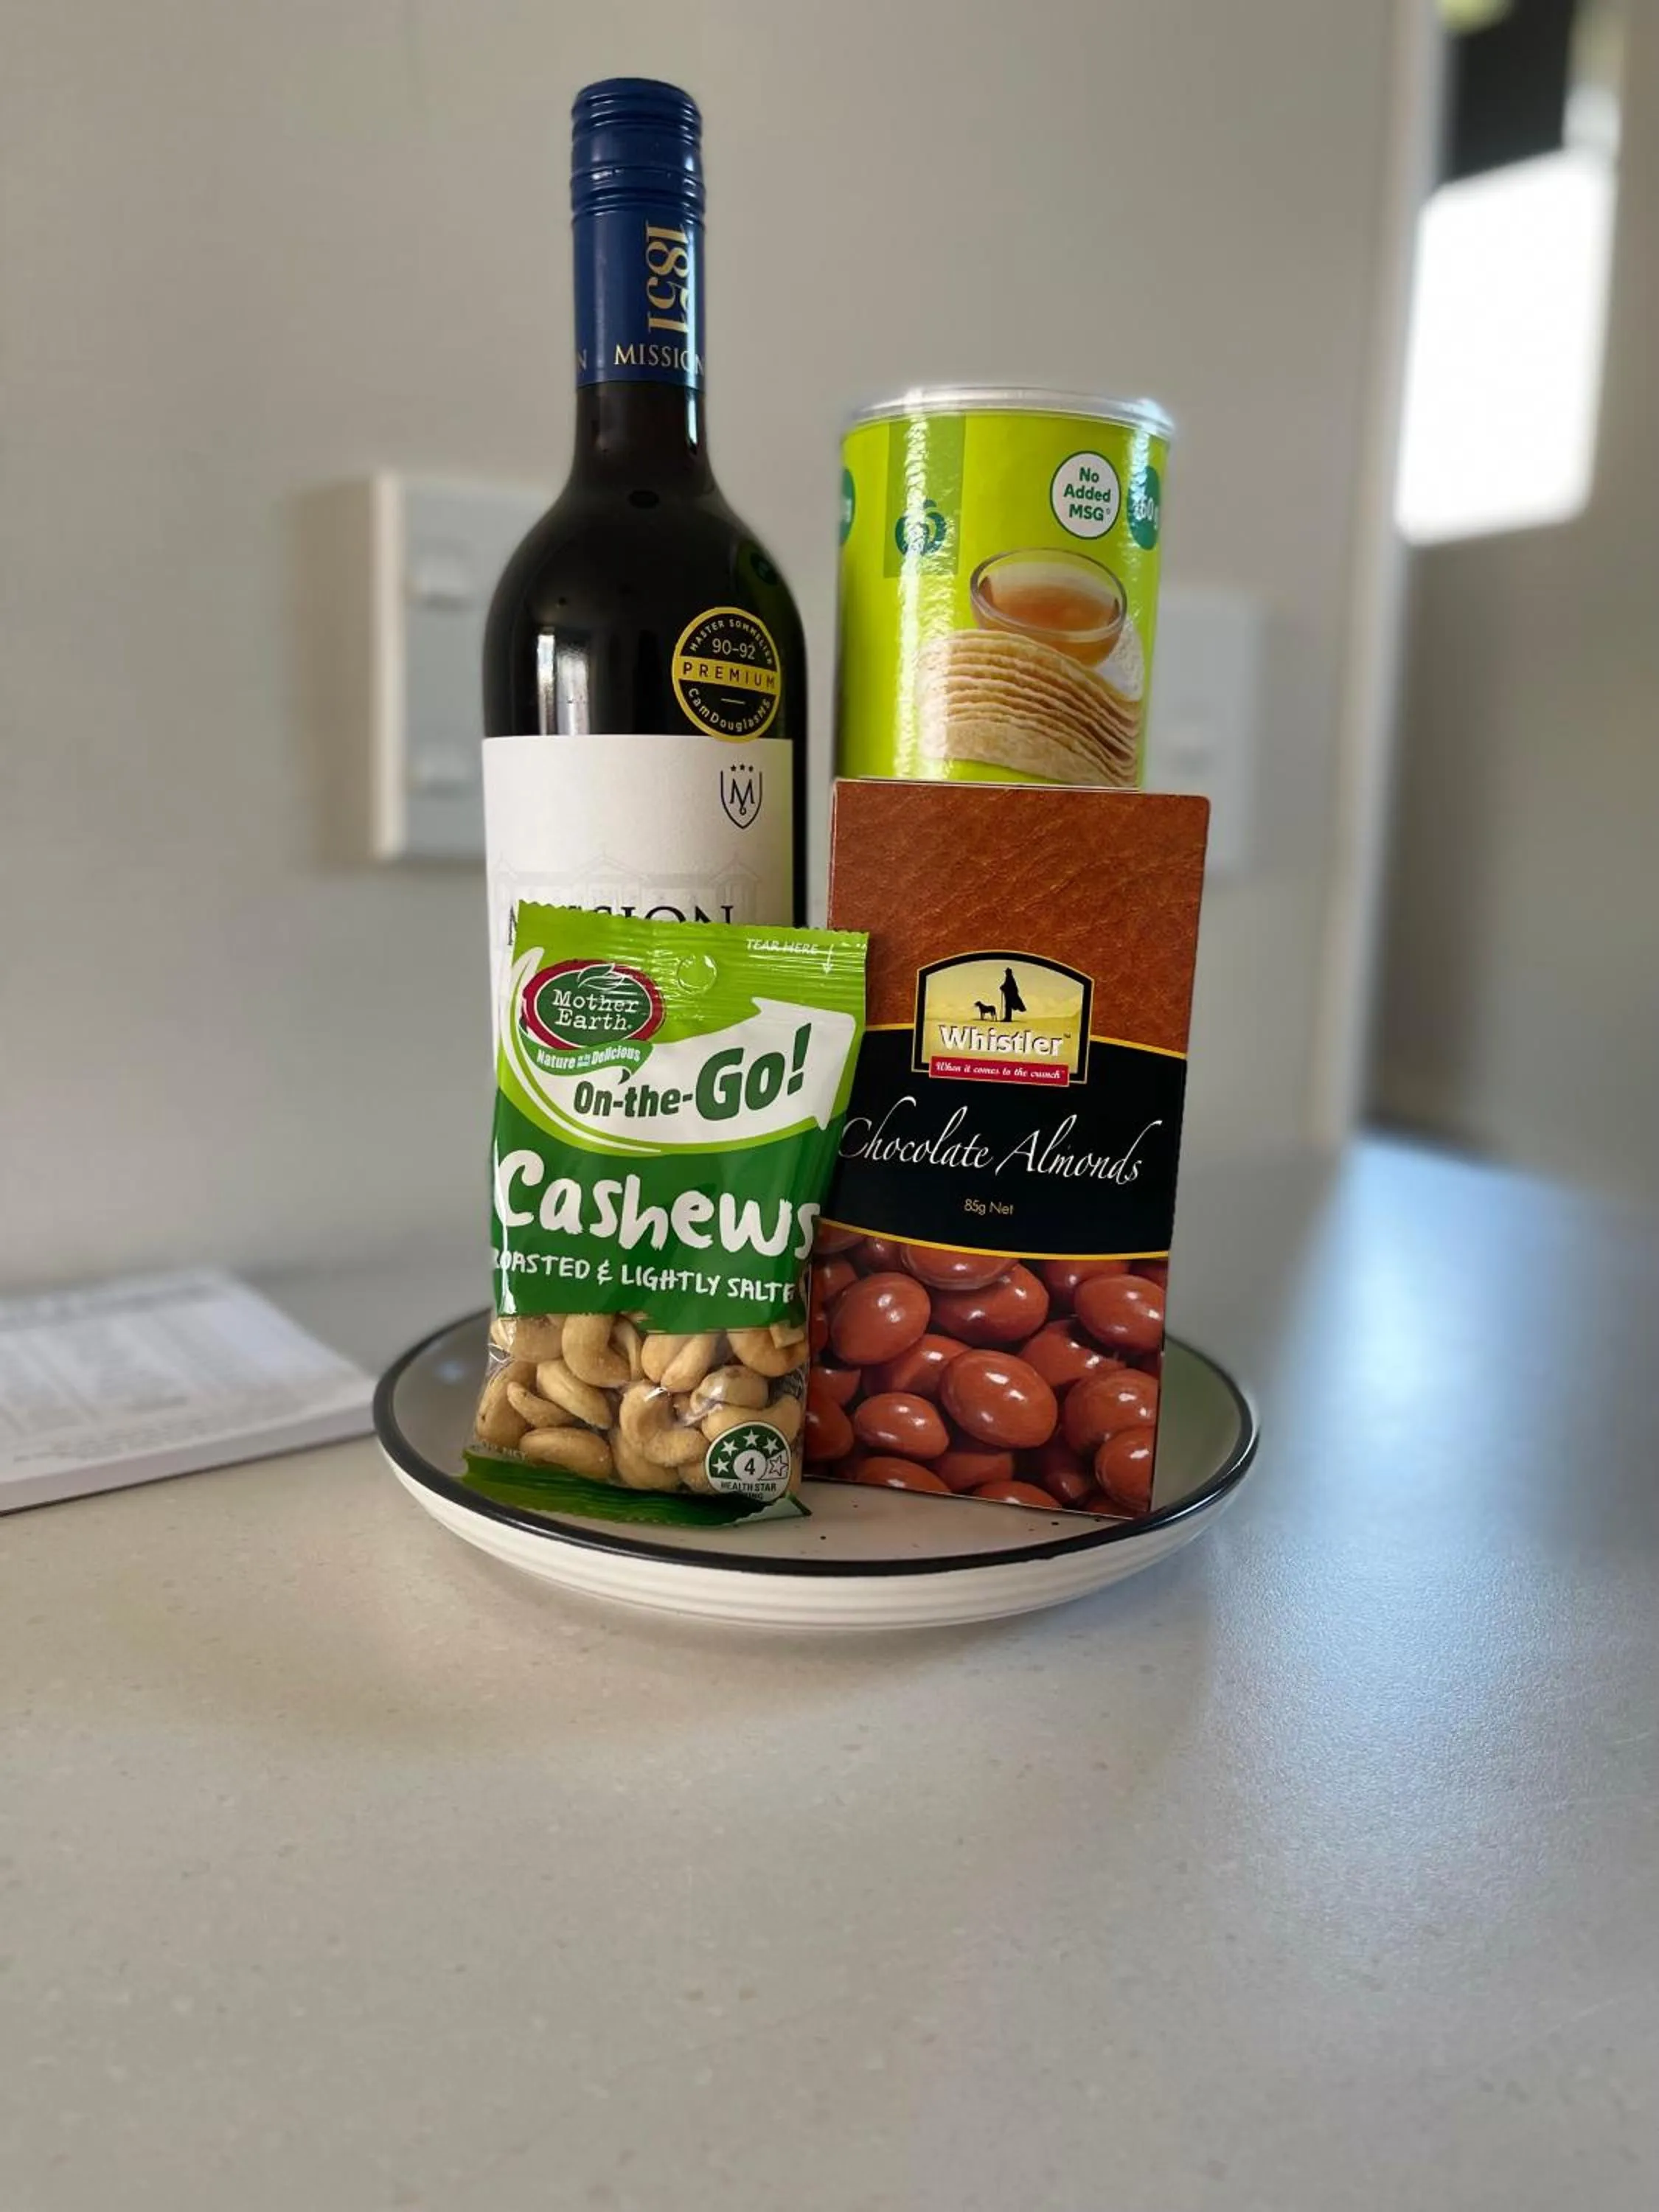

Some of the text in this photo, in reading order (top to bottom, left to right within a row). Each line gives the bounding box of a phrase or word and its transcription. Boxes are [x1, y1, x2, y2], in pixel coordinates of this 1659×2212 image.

[645, 222, 690, 333] 1851
[1079, 466, 1100, 483] No
[1063, 483, 1111, 503] Added
[689, 619, 773, 664] MASTER SOMMELIER
[712, 638, 756, 661] 90-92
[683, 661, 775, 689] PREMIUM
[745, 938, 819, 955] TEAR HERE
[552, 989, 640, 1013] Mother
[554, 1008, 628, 1030] Earth
[939, 1024, 1063, 1057] Whistler
[536, 1048, 577, 1069] Nature
[591, 1045, 641, 1065] Delicious
[935, 1060, 1062, 1079] When it comes to the crunch
[838, 1095, 1163, 1185] Chocolate Almonds
[496, 1150, 821, 1260] Cashews
[964, 1198, 1014, 1216] 85g Net
[597, 1259, 613, 1286] &
[621, 1264, 721, 1296] LIGHTLY
[726, 1277, 796, 1304] SALTE
[743, 1458, 756, 1475] 4
[720, 1481, 776, 1492] HEALTH STAR
